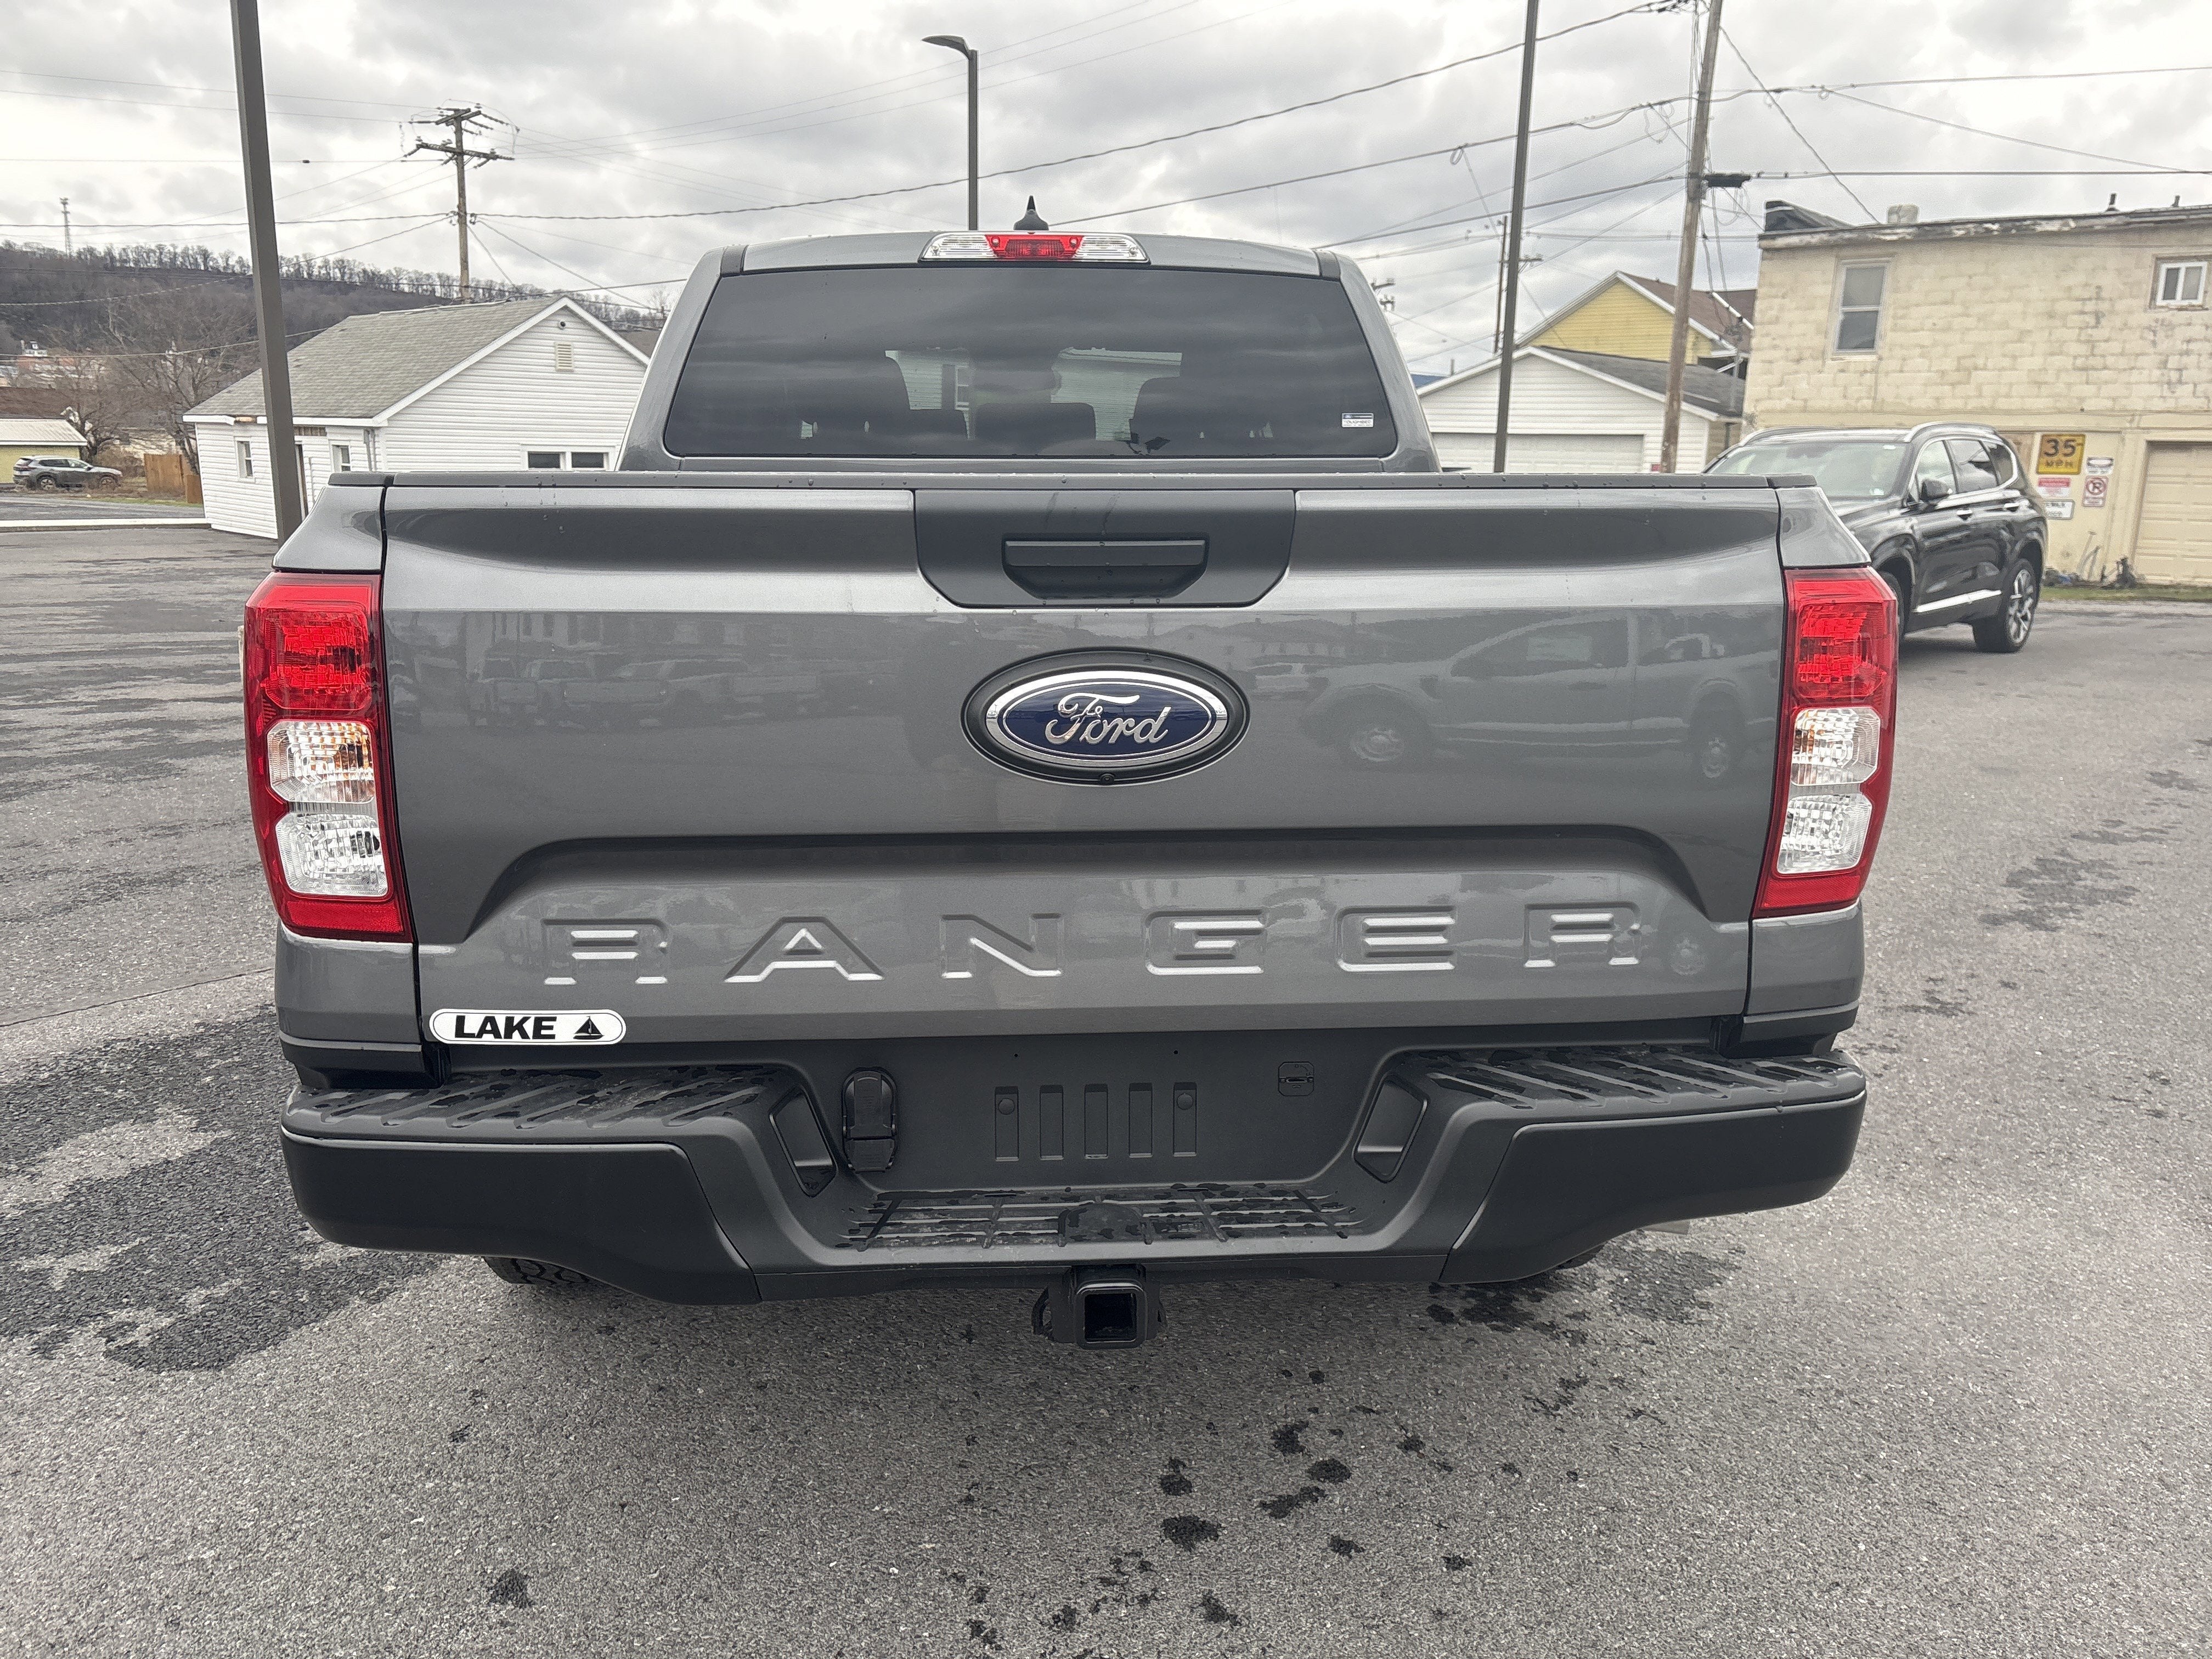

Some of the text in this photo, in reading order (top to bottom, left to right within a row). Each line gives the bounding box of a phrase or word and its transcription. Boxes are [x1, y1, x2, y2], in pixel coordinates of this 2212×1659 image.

[2044, 439, 2076, 457] 35
[2045, 460, 2074, 468] MPH
[1045, 692, 1172, 744] Ford
[542, 901, 1641, 984] RANGER
[454, 1015, 557, 1040] LAKE
